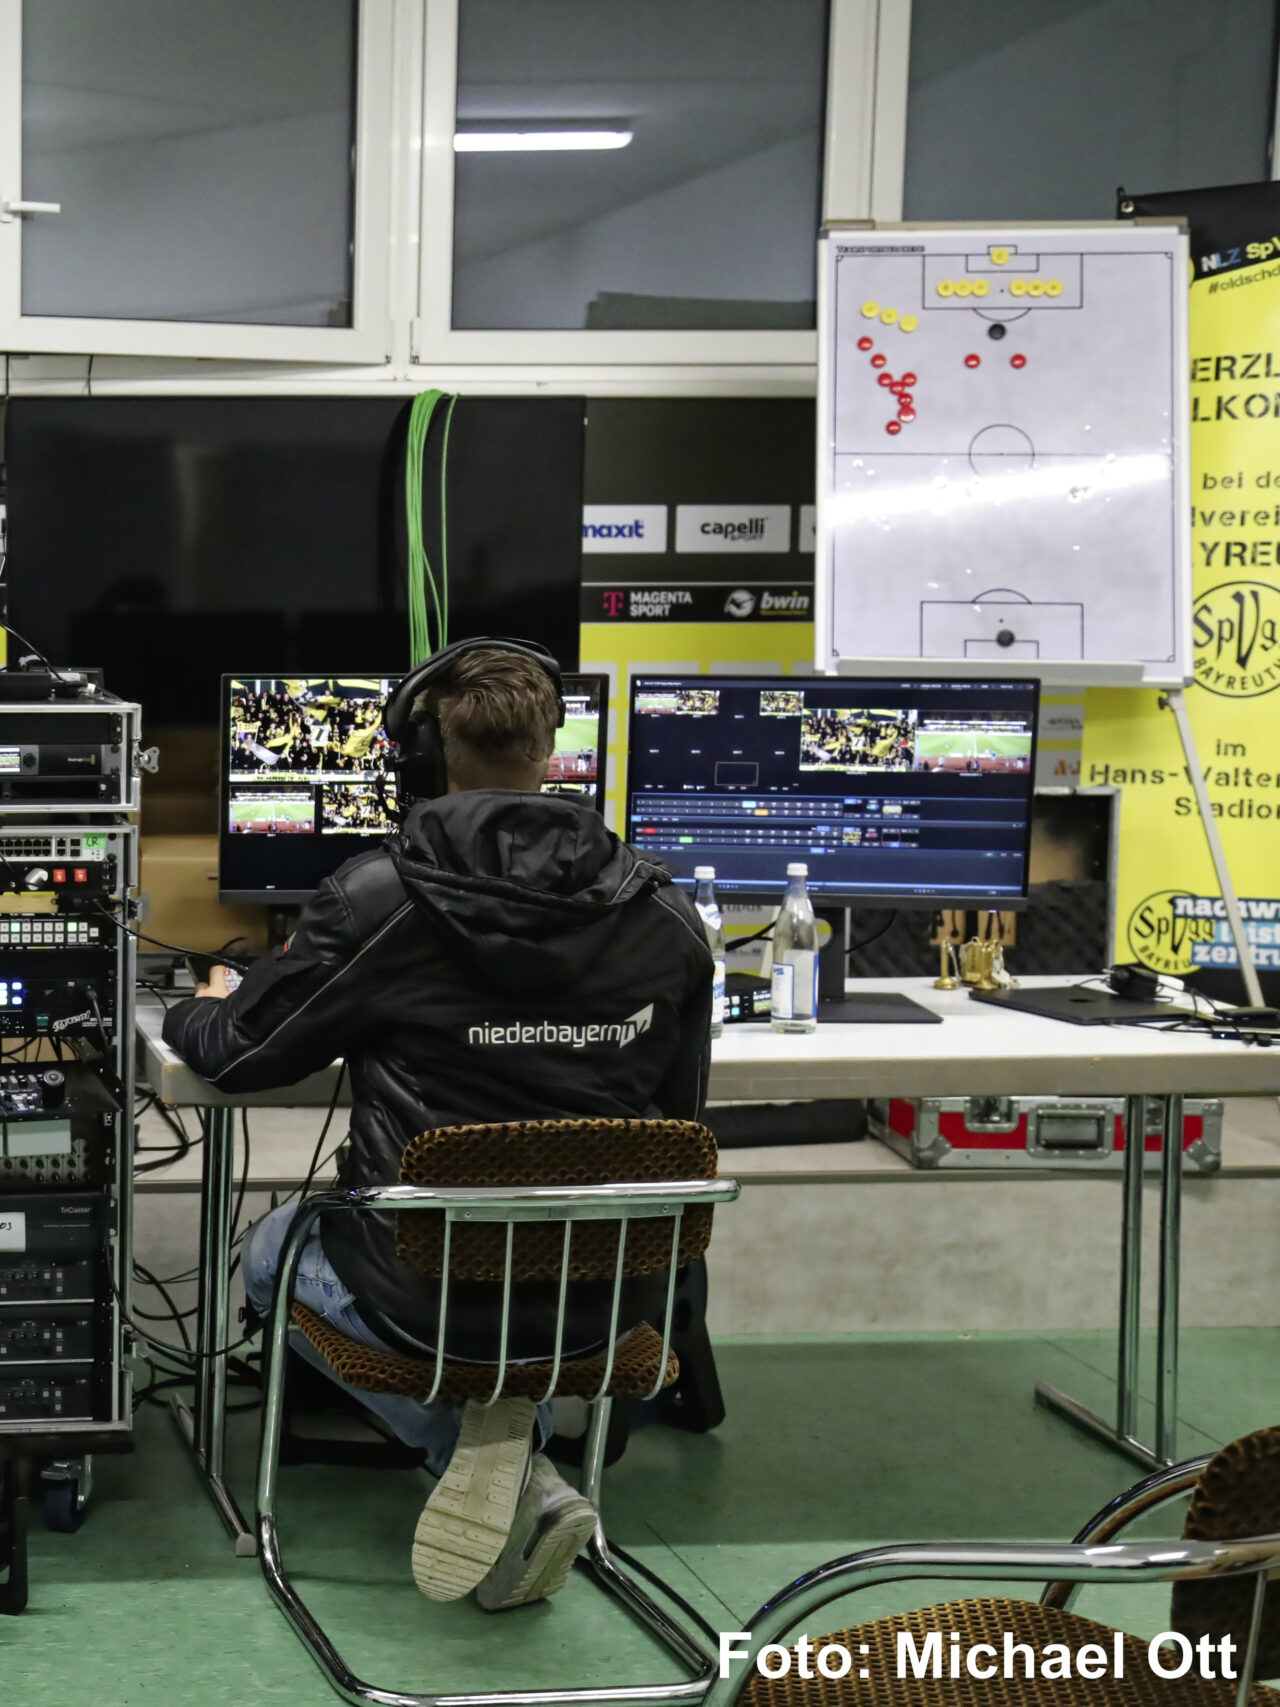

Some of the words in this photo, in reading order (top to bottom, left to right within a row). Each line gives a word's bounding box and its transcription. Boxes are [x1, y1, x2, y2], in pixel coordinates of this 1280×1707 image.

[1200, 248, 1241, 272] NLZ
[1202, 472, 1243, 490] bei
[701, 517, 764, 540] capelli
[630, 591, 693, 604] MAGENTA
[760, 590, 809, 609] bwin
[630, 604, 671, 617] SPORT
[1216, 739, 1246, 756] im
